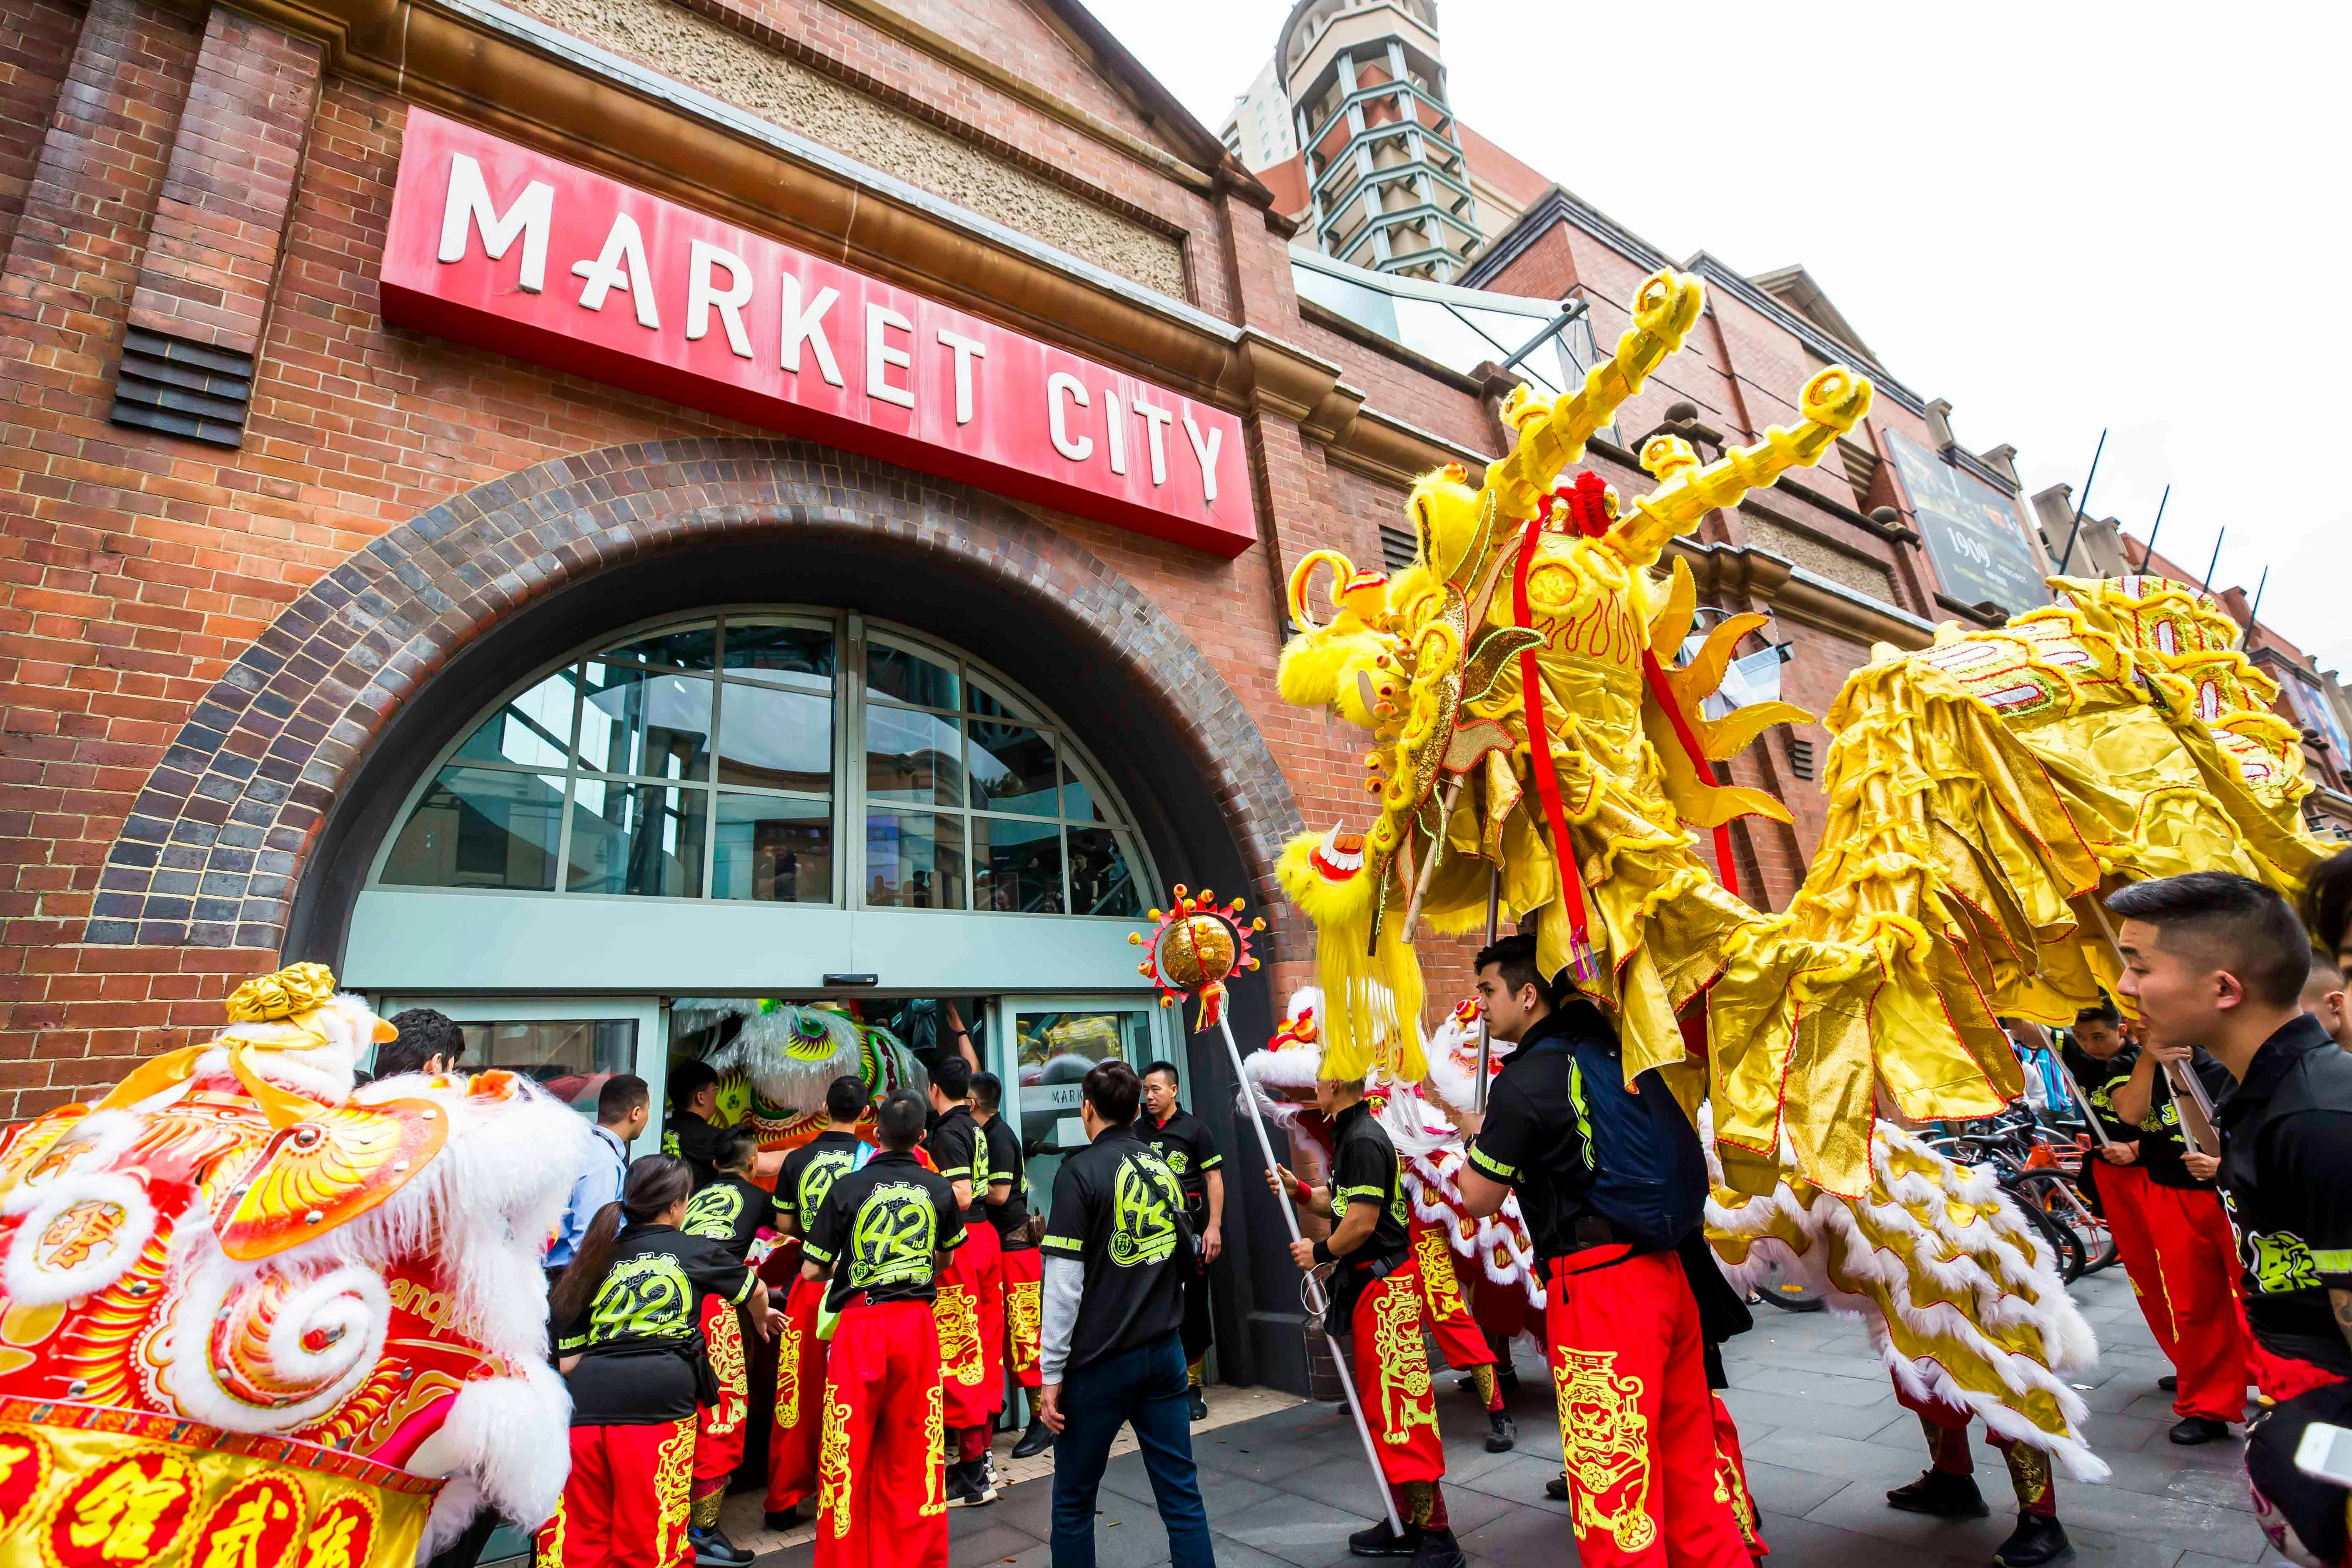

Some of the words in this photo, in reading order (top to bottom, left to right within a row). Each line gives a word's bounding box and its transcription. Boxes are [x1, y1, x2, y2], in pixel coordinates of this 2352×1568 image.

[438, 152, 985, 426] MARKET
[1047, 372, 1223, 501] CITY
[1945, 526, 1991, 568] 1909
[1052, 1089, 1083, 1103] MARK
